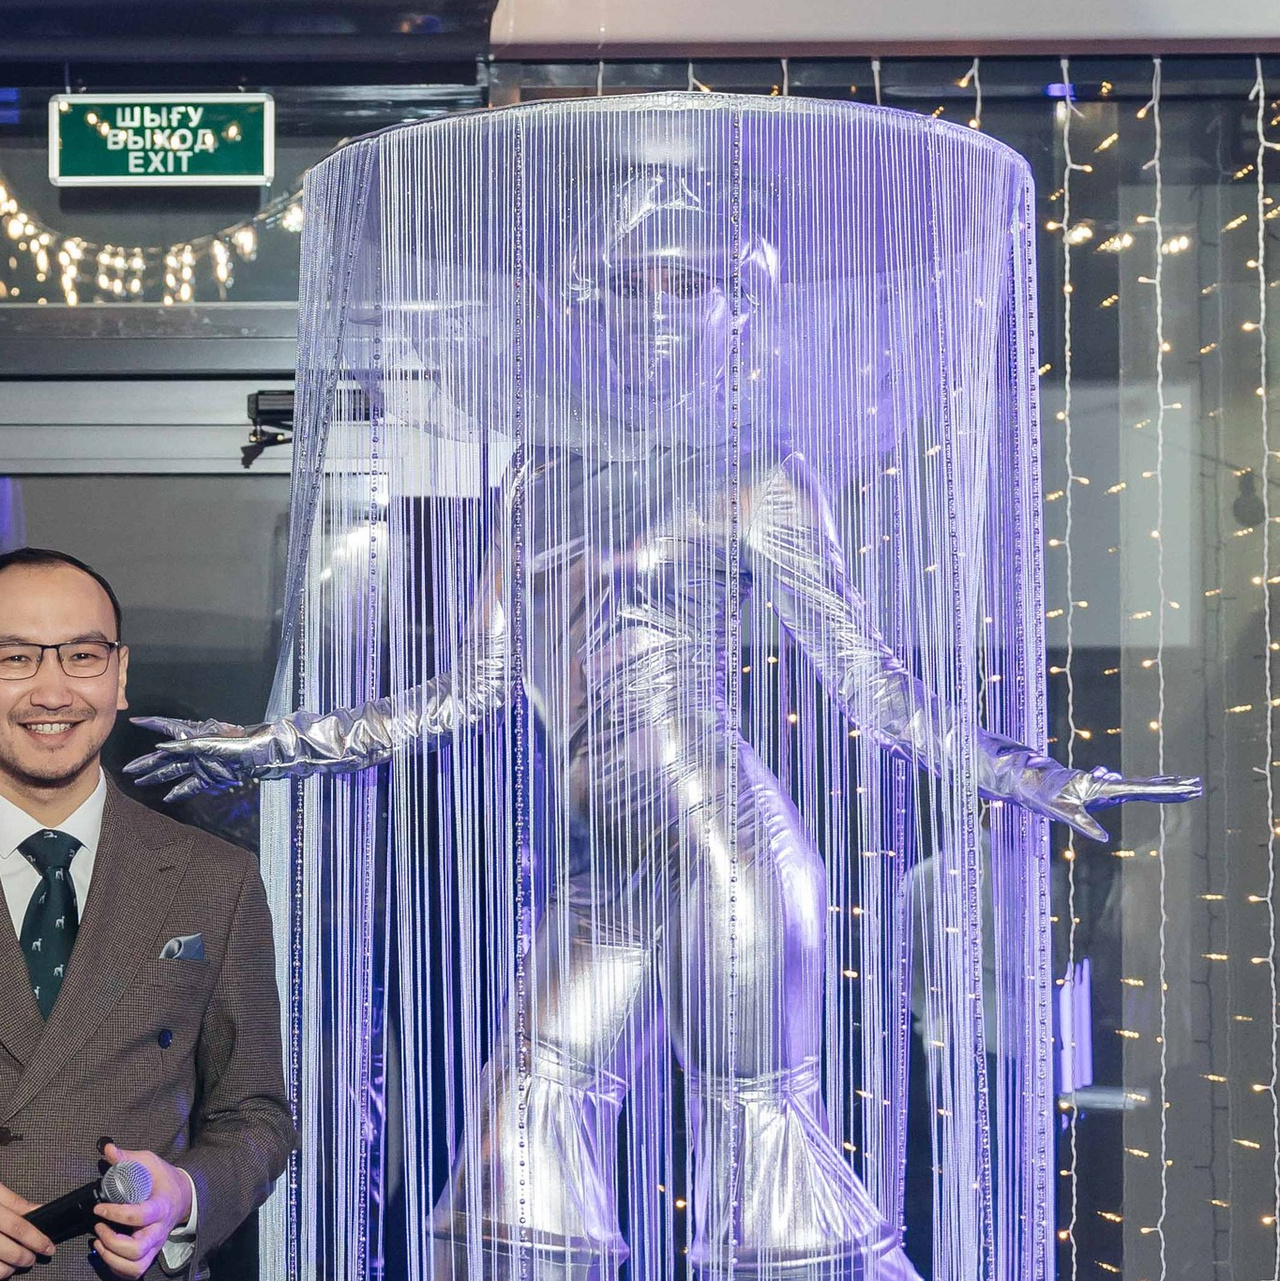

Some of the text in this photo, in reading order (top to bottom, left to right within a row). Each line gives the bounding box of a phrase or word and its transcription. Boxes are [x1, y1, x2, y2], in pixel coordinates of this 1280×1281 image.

[116, 106, 204, 128] ШЫҒУ
[107, 128, 216, 153] ВЫХОД
[128, 151, 193, 173] EXIT
